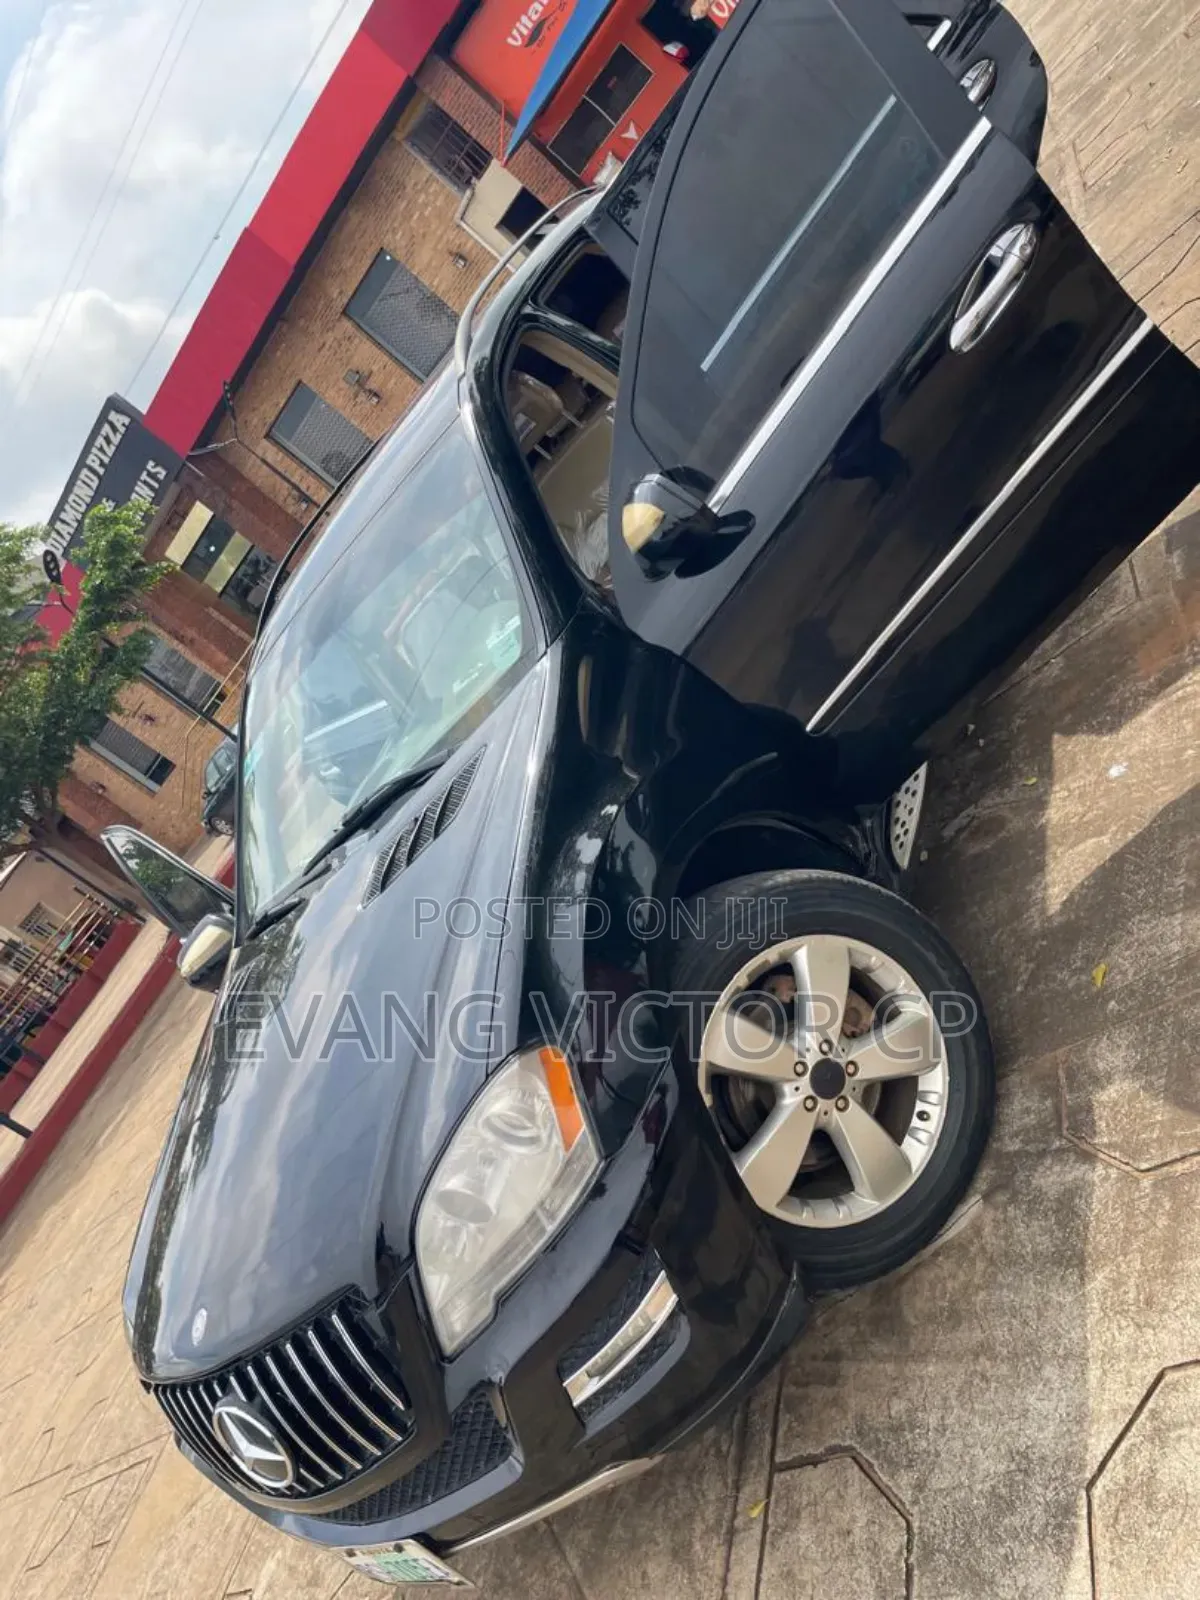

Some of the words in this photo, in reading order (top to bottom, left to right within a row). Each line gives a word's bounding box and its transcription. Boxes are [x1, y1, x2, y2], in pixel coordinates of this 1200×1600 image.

[506, 0, 549, 46] Vita
[47, 467, 100, 556] DIAMOND
[85, 409, 131, 476] PIZZA
